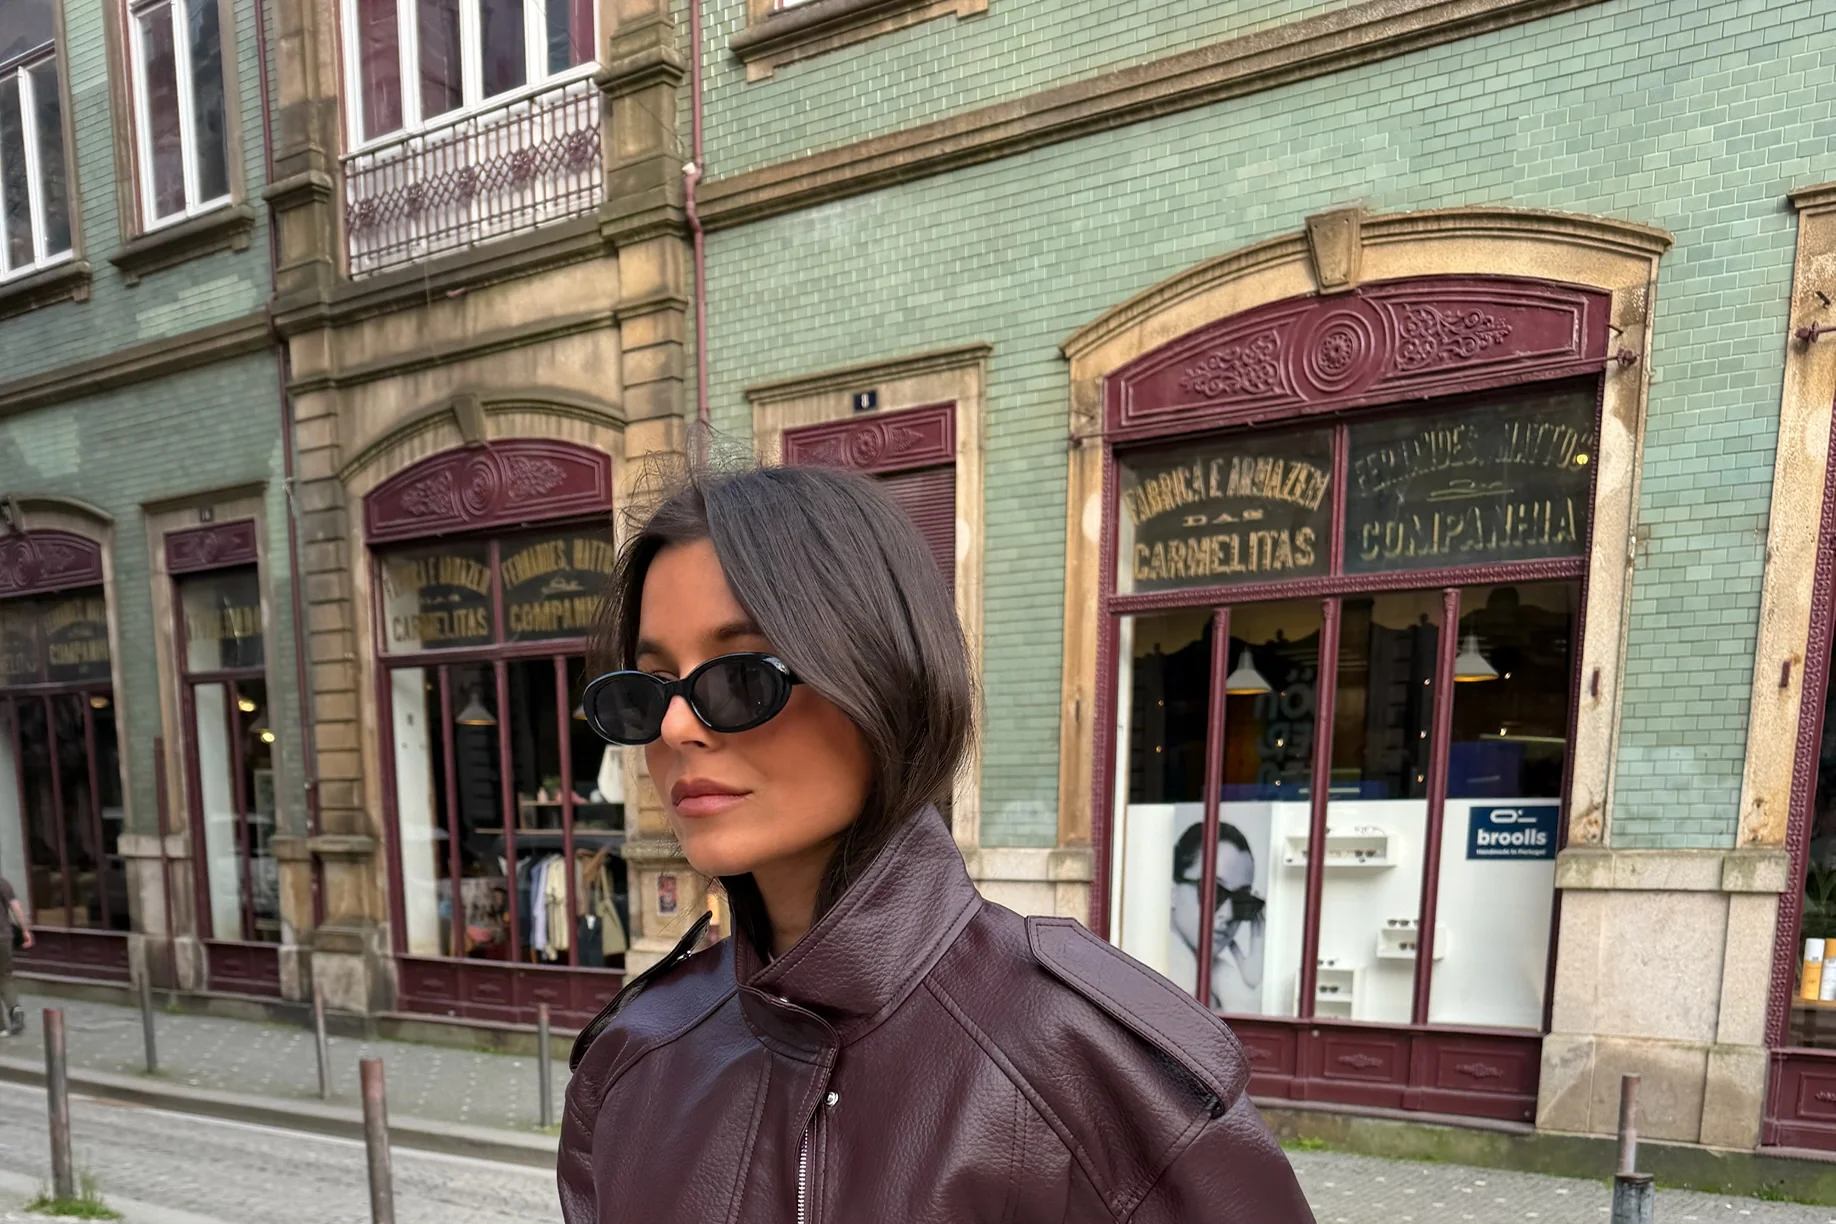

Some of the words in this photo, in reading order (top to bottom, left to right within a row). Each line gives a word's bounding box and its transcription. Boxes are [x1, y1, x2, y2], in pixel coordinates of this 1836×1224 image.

[1210, 457, 1225, 498] E
[1182, 508, 1264, 528] DAS
[1134, 526, 1316, 581] CARMELITAS
[1476, 828, 1547, 846] broolls
